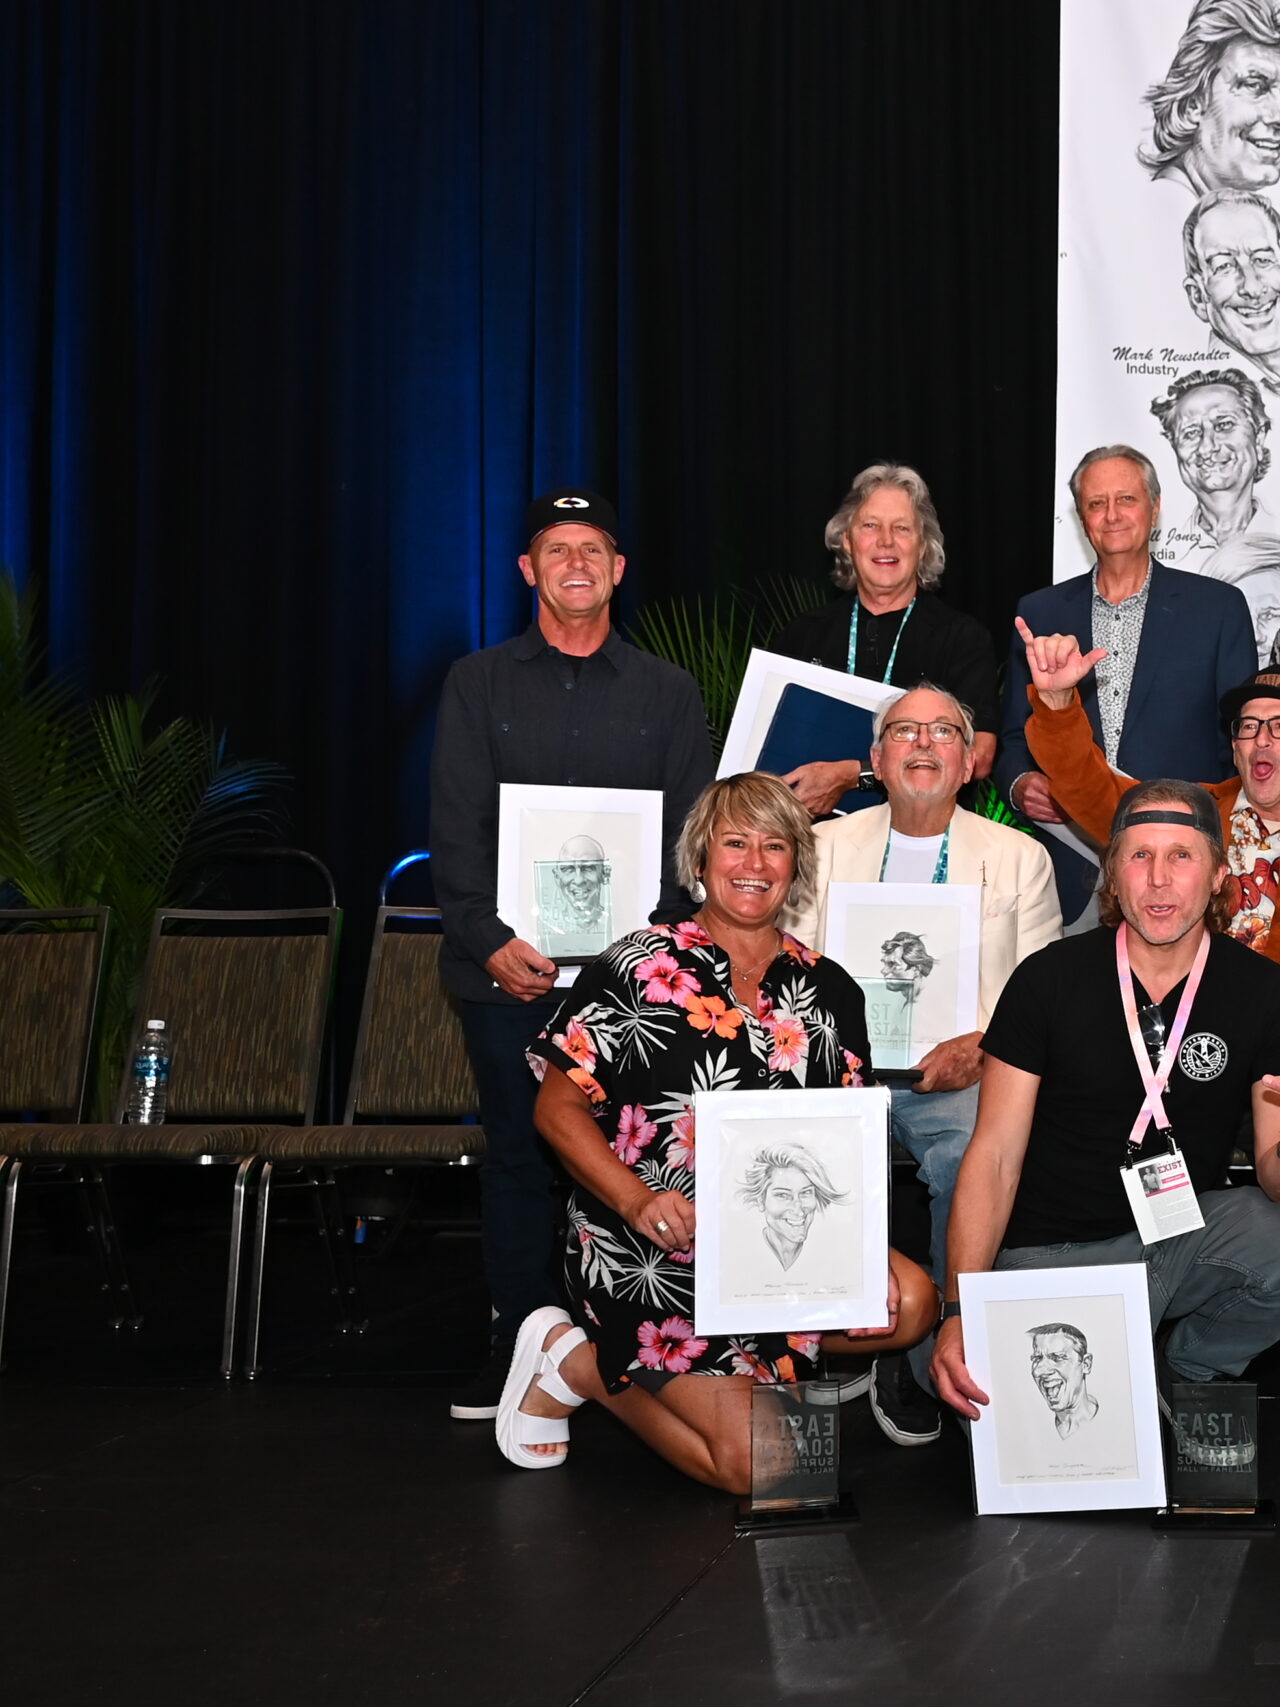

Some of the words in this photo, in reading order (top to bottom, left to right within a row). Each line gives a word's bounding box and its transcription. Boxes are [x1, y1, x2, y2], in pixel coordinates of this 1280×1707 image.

[1113, 346, 1154, 361] Mark
[1160, 347, 1232, 362] Neustadter
[1126, 363, 1179, 377] Industry
[1150, 530, 1161, 541] ll
[1166, 528, 1201, 545] Jones
[1150, 549, 1175, 560] edia
[1157, 1160, 1182, 1174] EXIST
[1176, 1413, 1233, 1436] EAST
[1176, 1437, 1233, 1455] COAST
